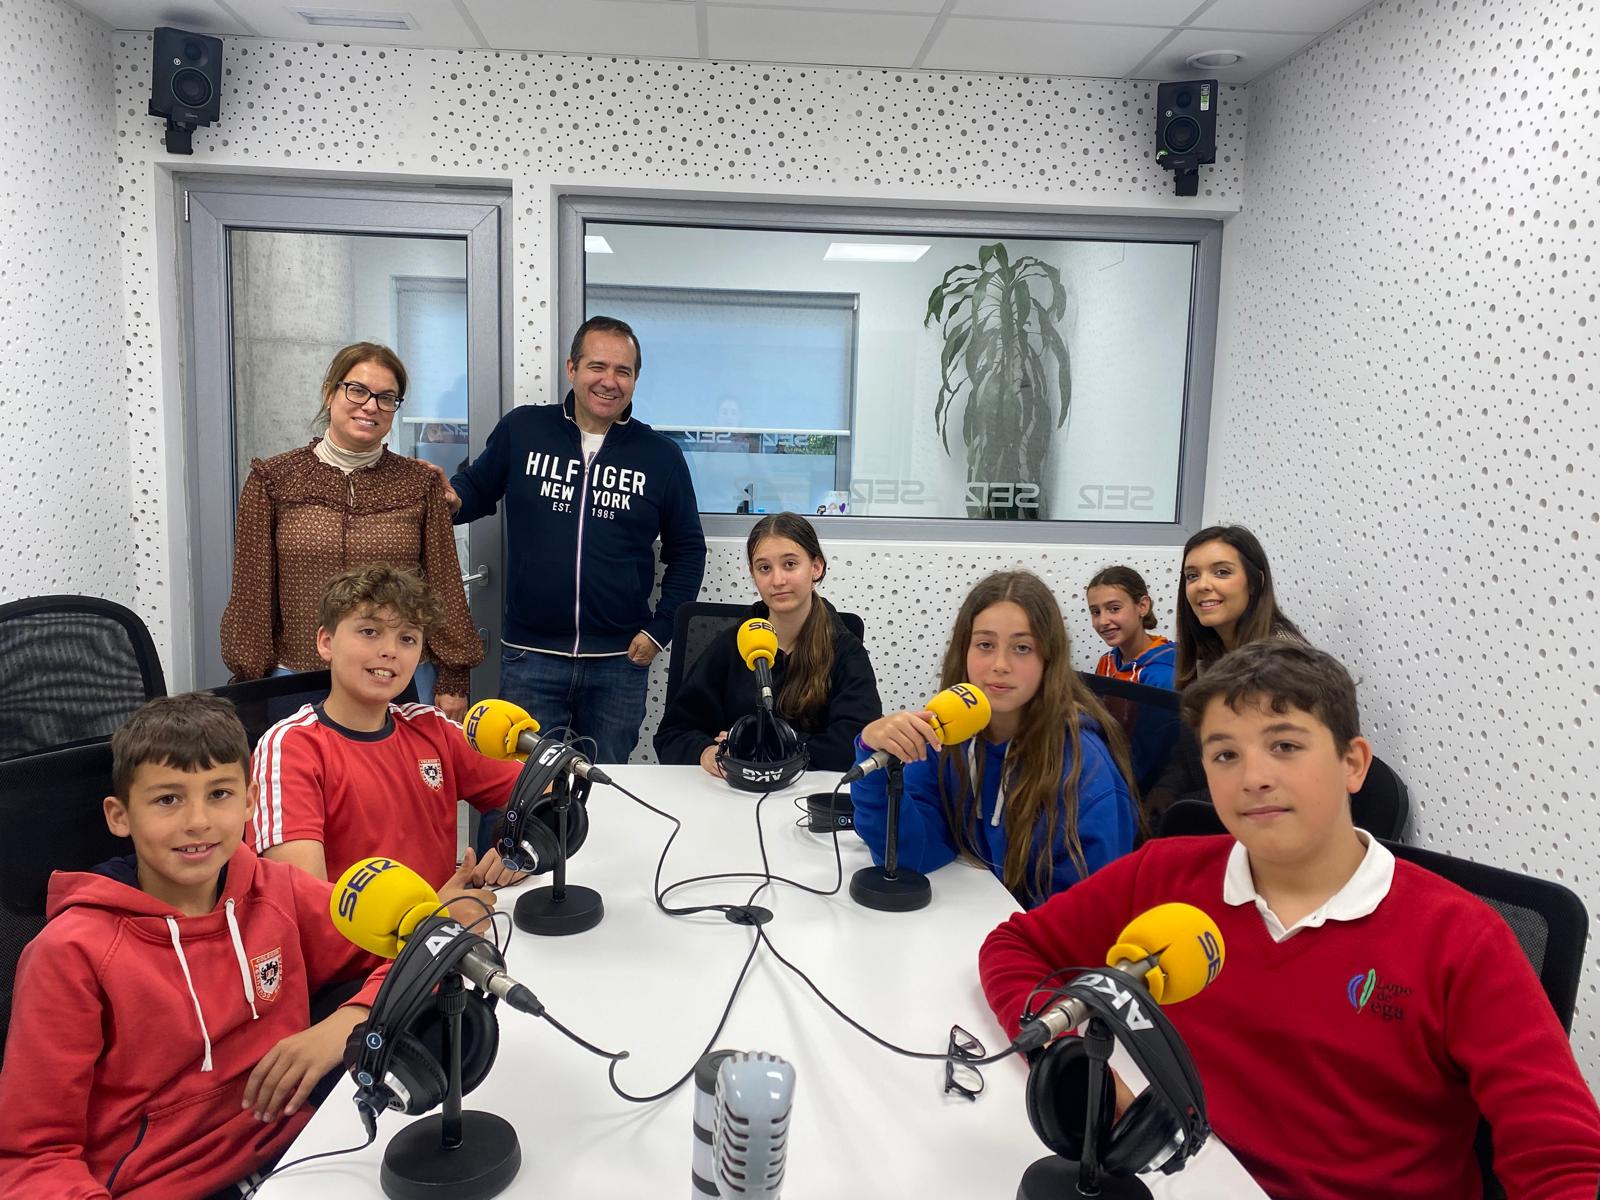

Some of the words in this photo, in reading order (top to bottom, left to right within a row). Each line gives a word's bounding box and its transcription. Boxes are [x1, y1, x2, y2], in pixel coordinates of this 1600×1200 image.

[525, 451, 646, 496] HILFIGER
[540, 481, 575, 502] NEW
[592, 489, 631, 510] YORK
[552, 501, 572, 513] EST.
[591, 507, 615, 520] 1985
[742, 767, 784, 783] AKG
[338, 859, 400, 922] SER
